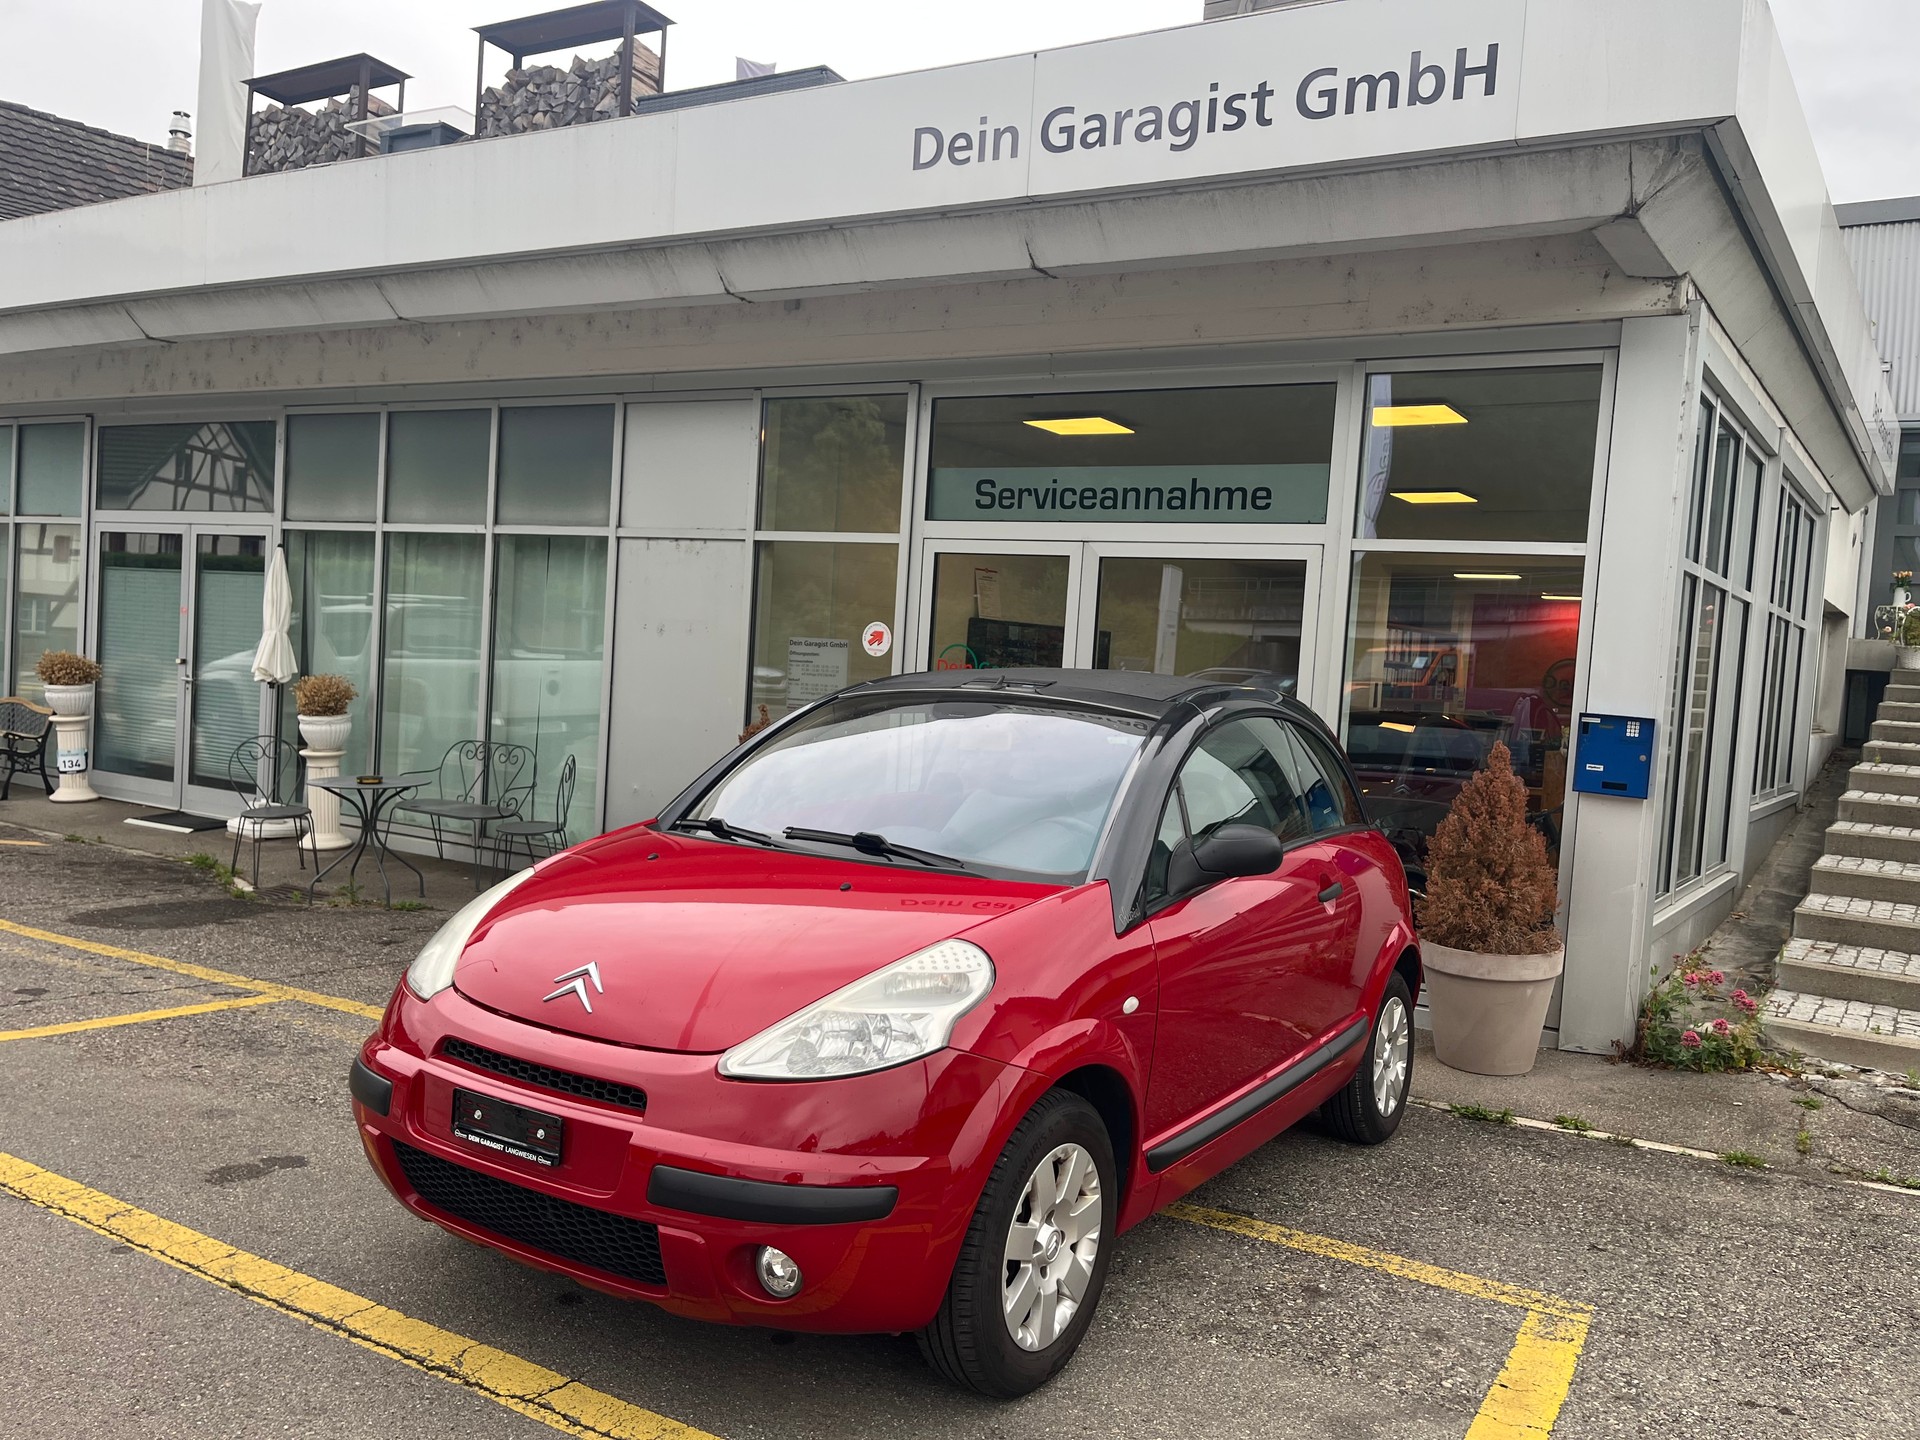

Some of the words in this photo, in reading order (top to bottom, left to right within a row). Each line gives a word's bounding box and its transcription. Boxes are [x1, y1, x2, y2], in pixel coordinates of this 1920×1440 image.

[911, 116, 1020, 171] Dein
[1040, 80, 1275, 153] Garagist
[1295, 43, 1500, 120] GmbH
[975, 477, 1273, 511] Serviceannahme
[804, 640, 829, 648] Garagist
[829, 641, 848, 649] GmbH
[62, 759, 81, 769] 134
[468, 1134, 480, 1144] DEIN
[480, 1137, 504, 1151] GARAGIST
[505, 1146, 537, 1161] LANGWIESEN
